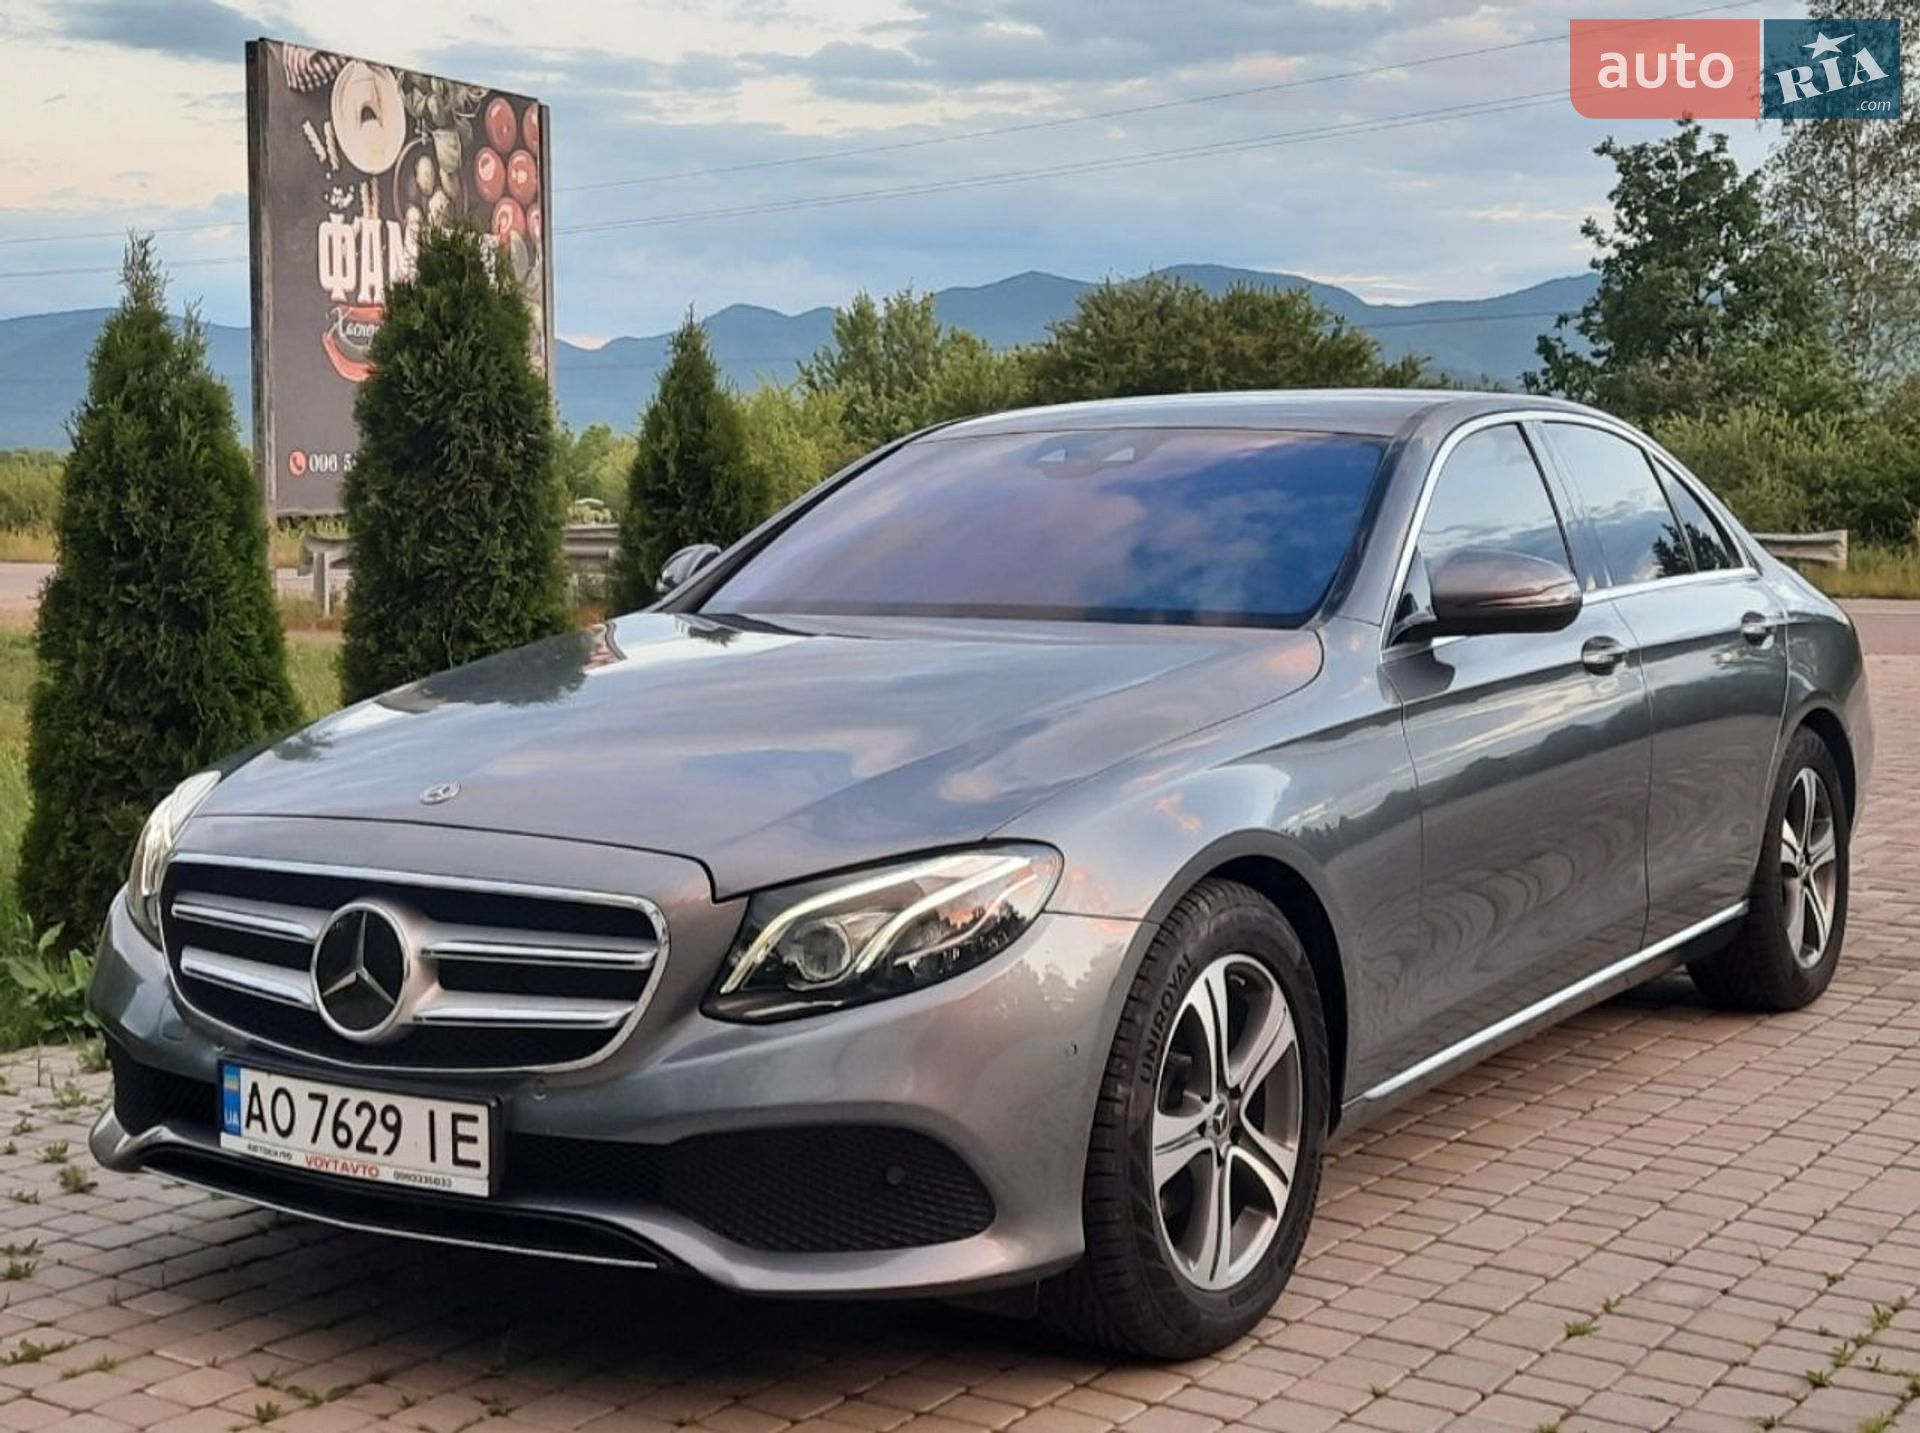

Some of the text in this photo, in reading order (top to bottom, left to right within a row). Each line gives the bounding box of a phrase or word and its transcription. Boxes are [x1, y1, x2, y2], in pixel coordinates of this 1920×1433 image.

[223, 1108, 240, 1127] UA
[245, 1081, 482, 1169] AO 7629 IE
[305, 1153, 381, 1179] VOYTAVTO
